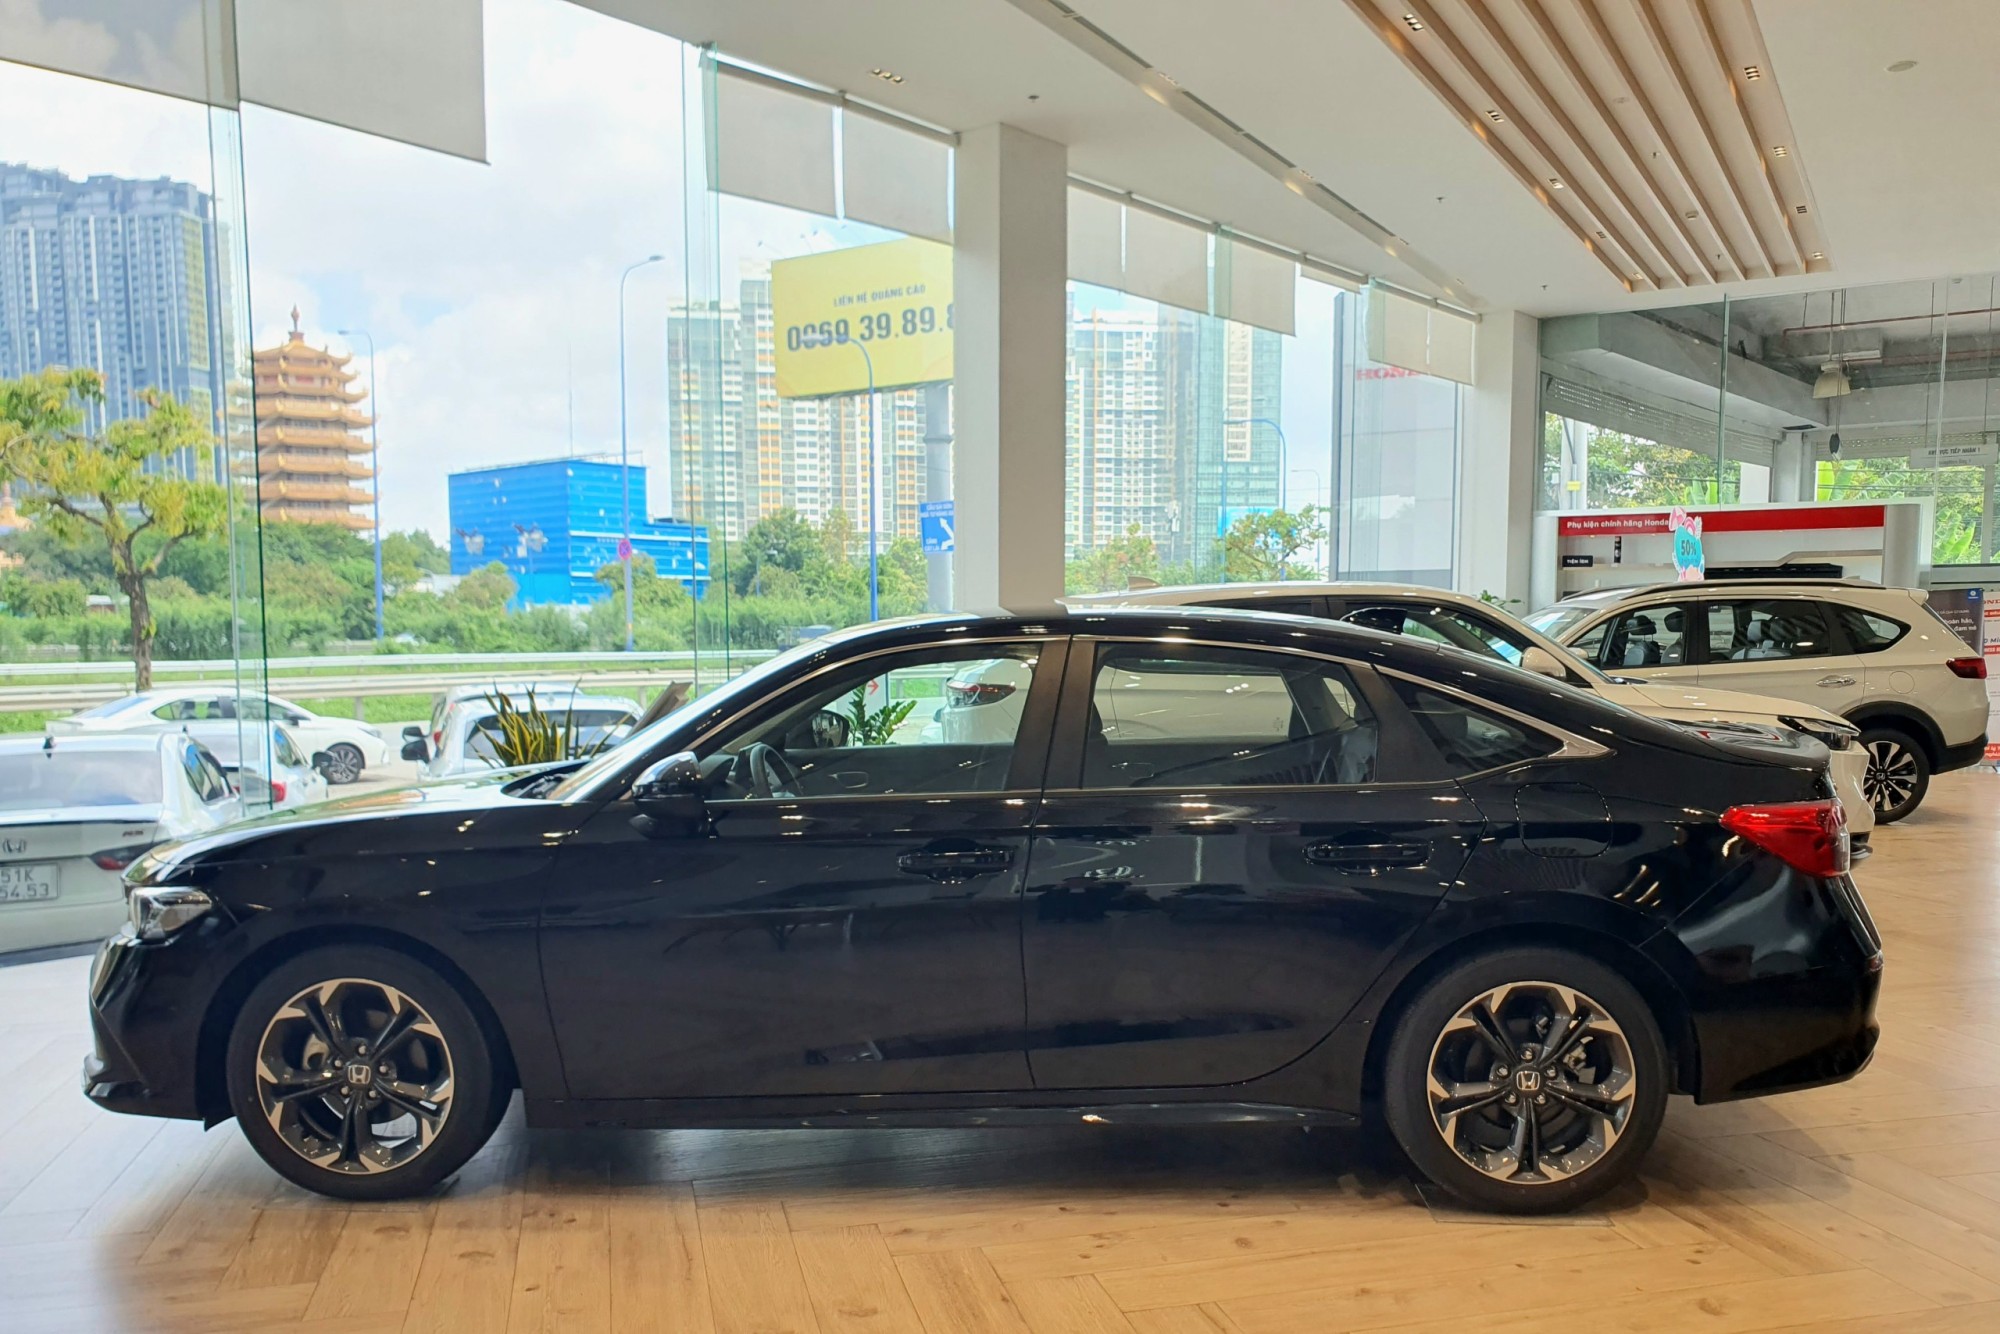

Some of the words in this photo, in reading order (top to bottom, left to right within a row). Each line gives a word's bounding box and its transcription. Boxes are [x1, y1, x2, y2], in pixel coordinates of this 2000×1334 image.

[1356, 366, 1418, 381] HON
[1567, 521, 1581, 529] Phụ
[1583, 520, 1599, 529] kiện
[1600, 519, 1621, 528] chính
[1644, 518, 1669, 527] Honda
